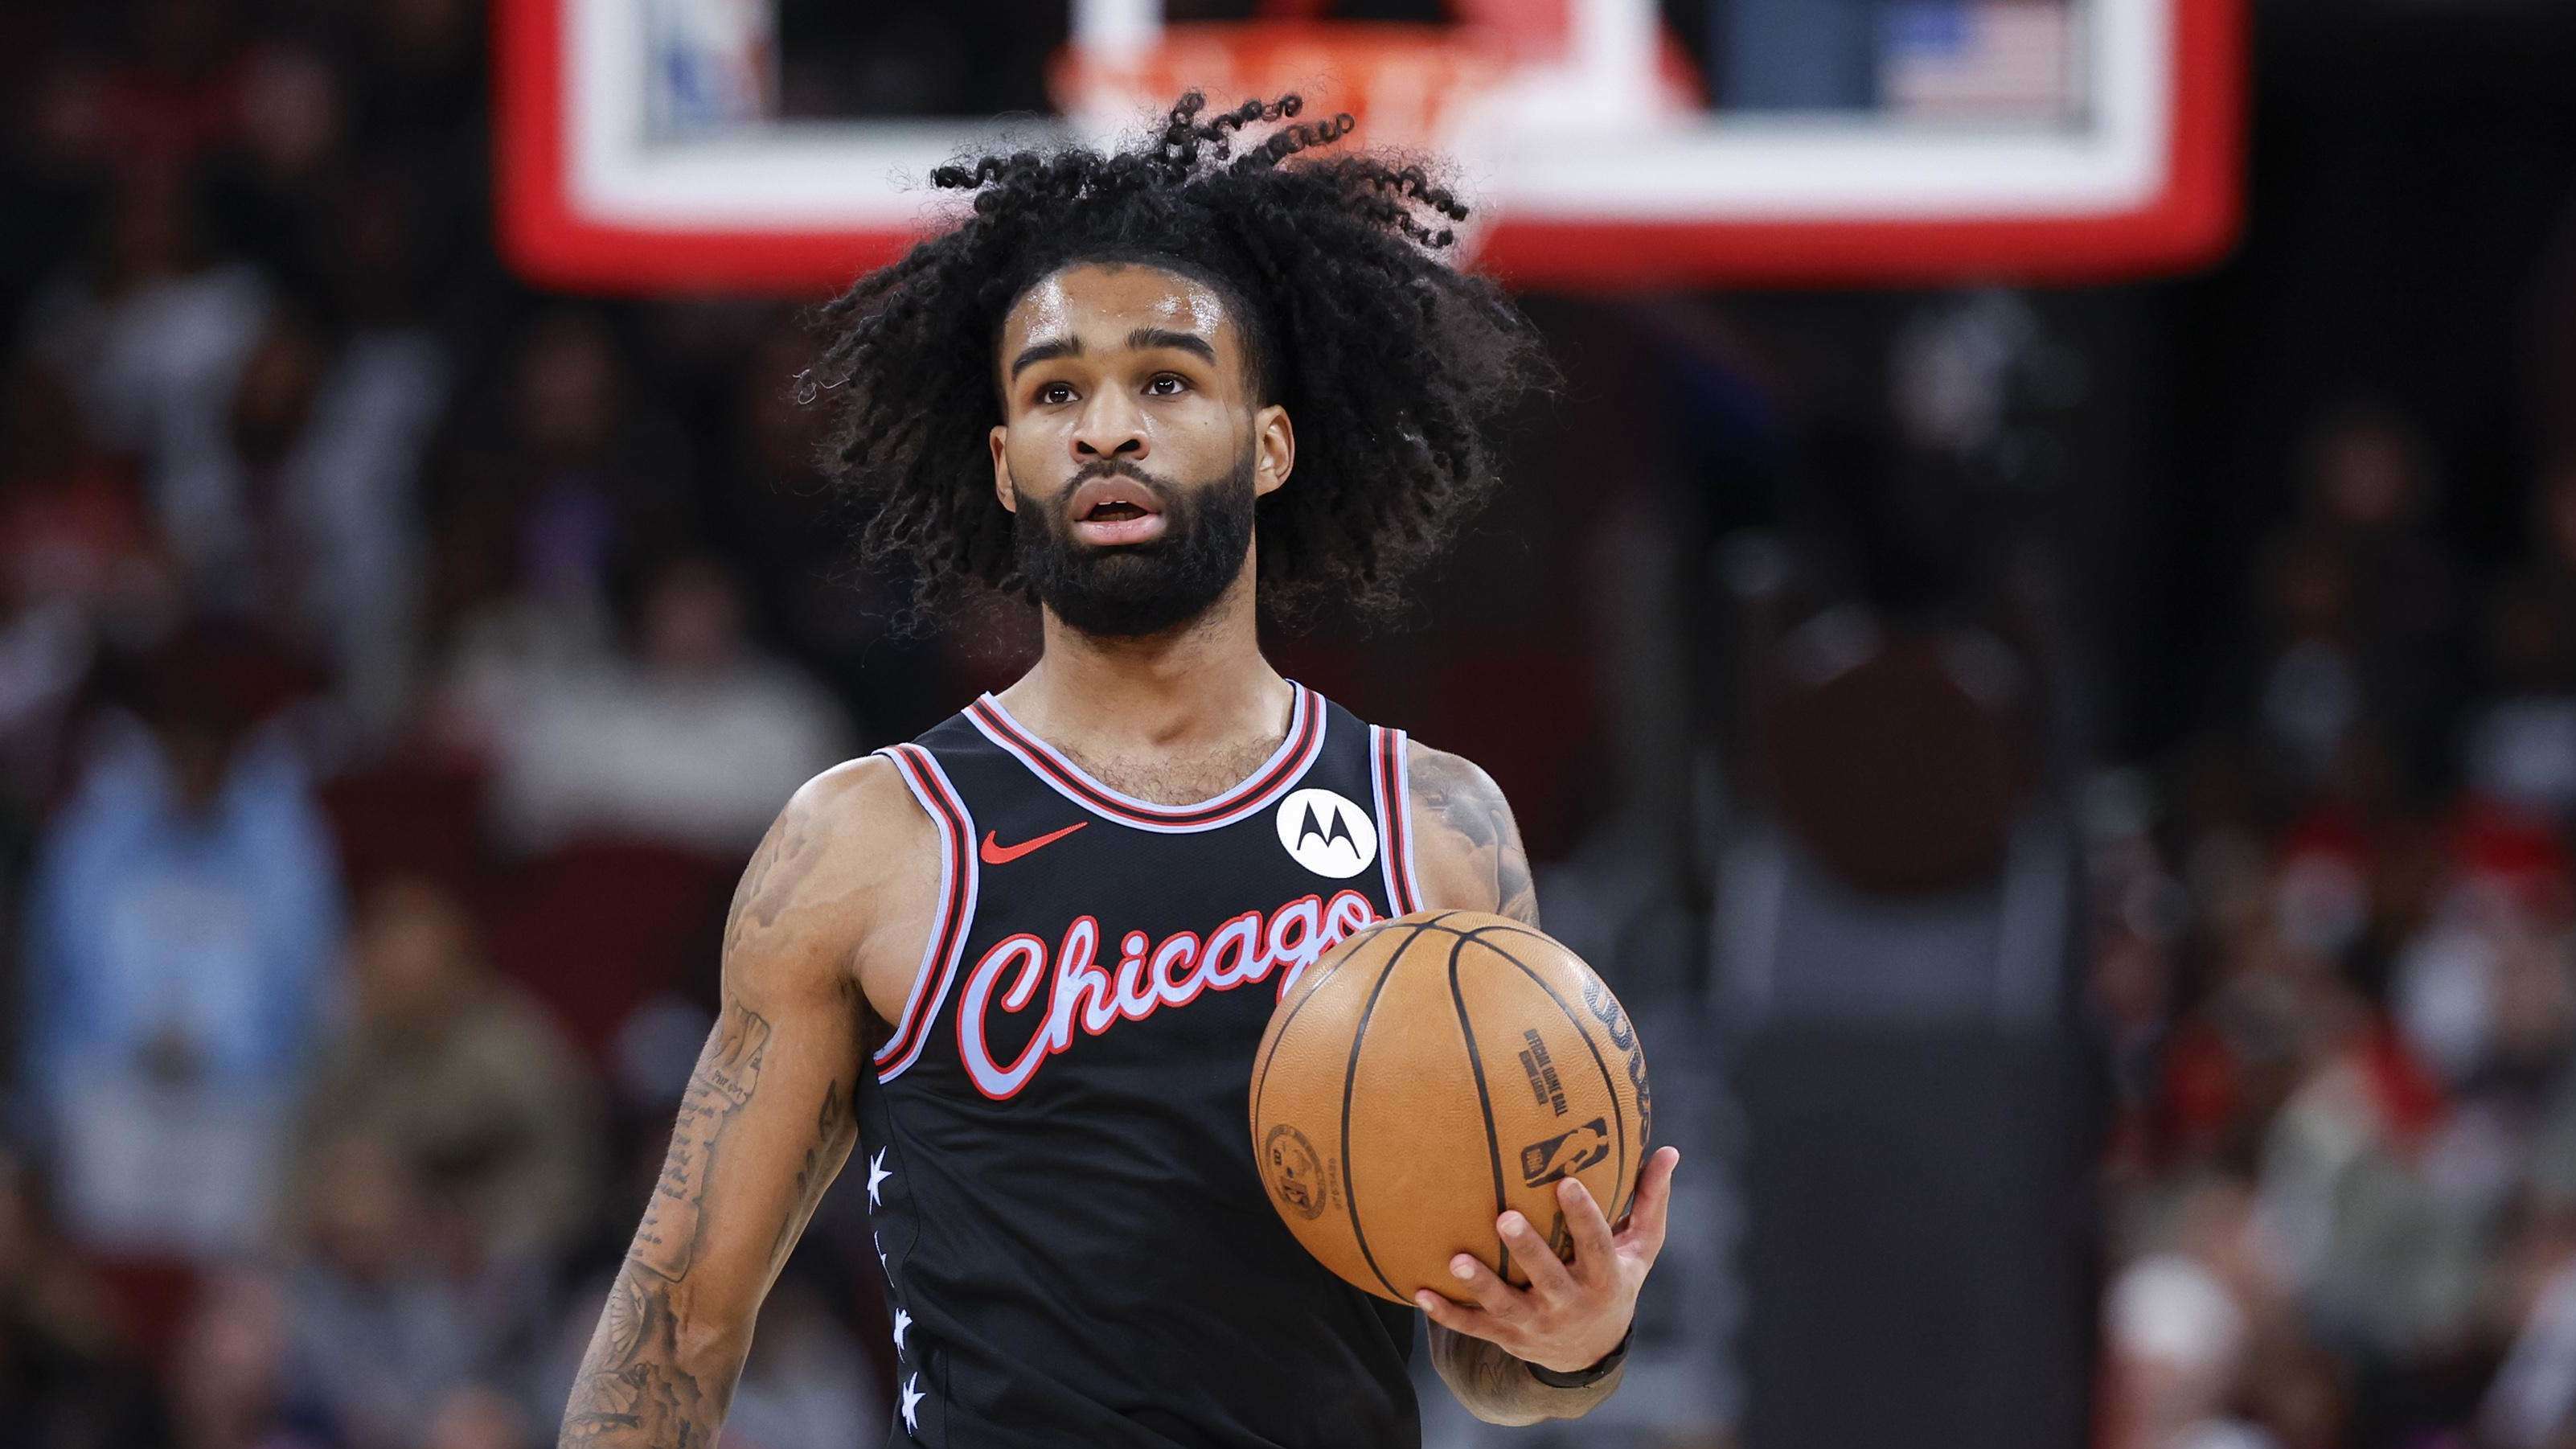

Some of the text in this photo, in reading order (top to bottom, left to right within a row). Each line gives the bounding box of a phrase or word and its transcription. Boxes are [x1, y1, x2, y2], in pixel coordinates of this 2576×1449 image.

[956, 889, 1384, 1101] Chicago
[1524, 1028, 1551, 1067] OFFICIAL
[1542, 1067, 1563, 1094] GAME
[1551, 1091, 1568, 1117] BALL
[1526, 1148, 1544, 1173] NBA
